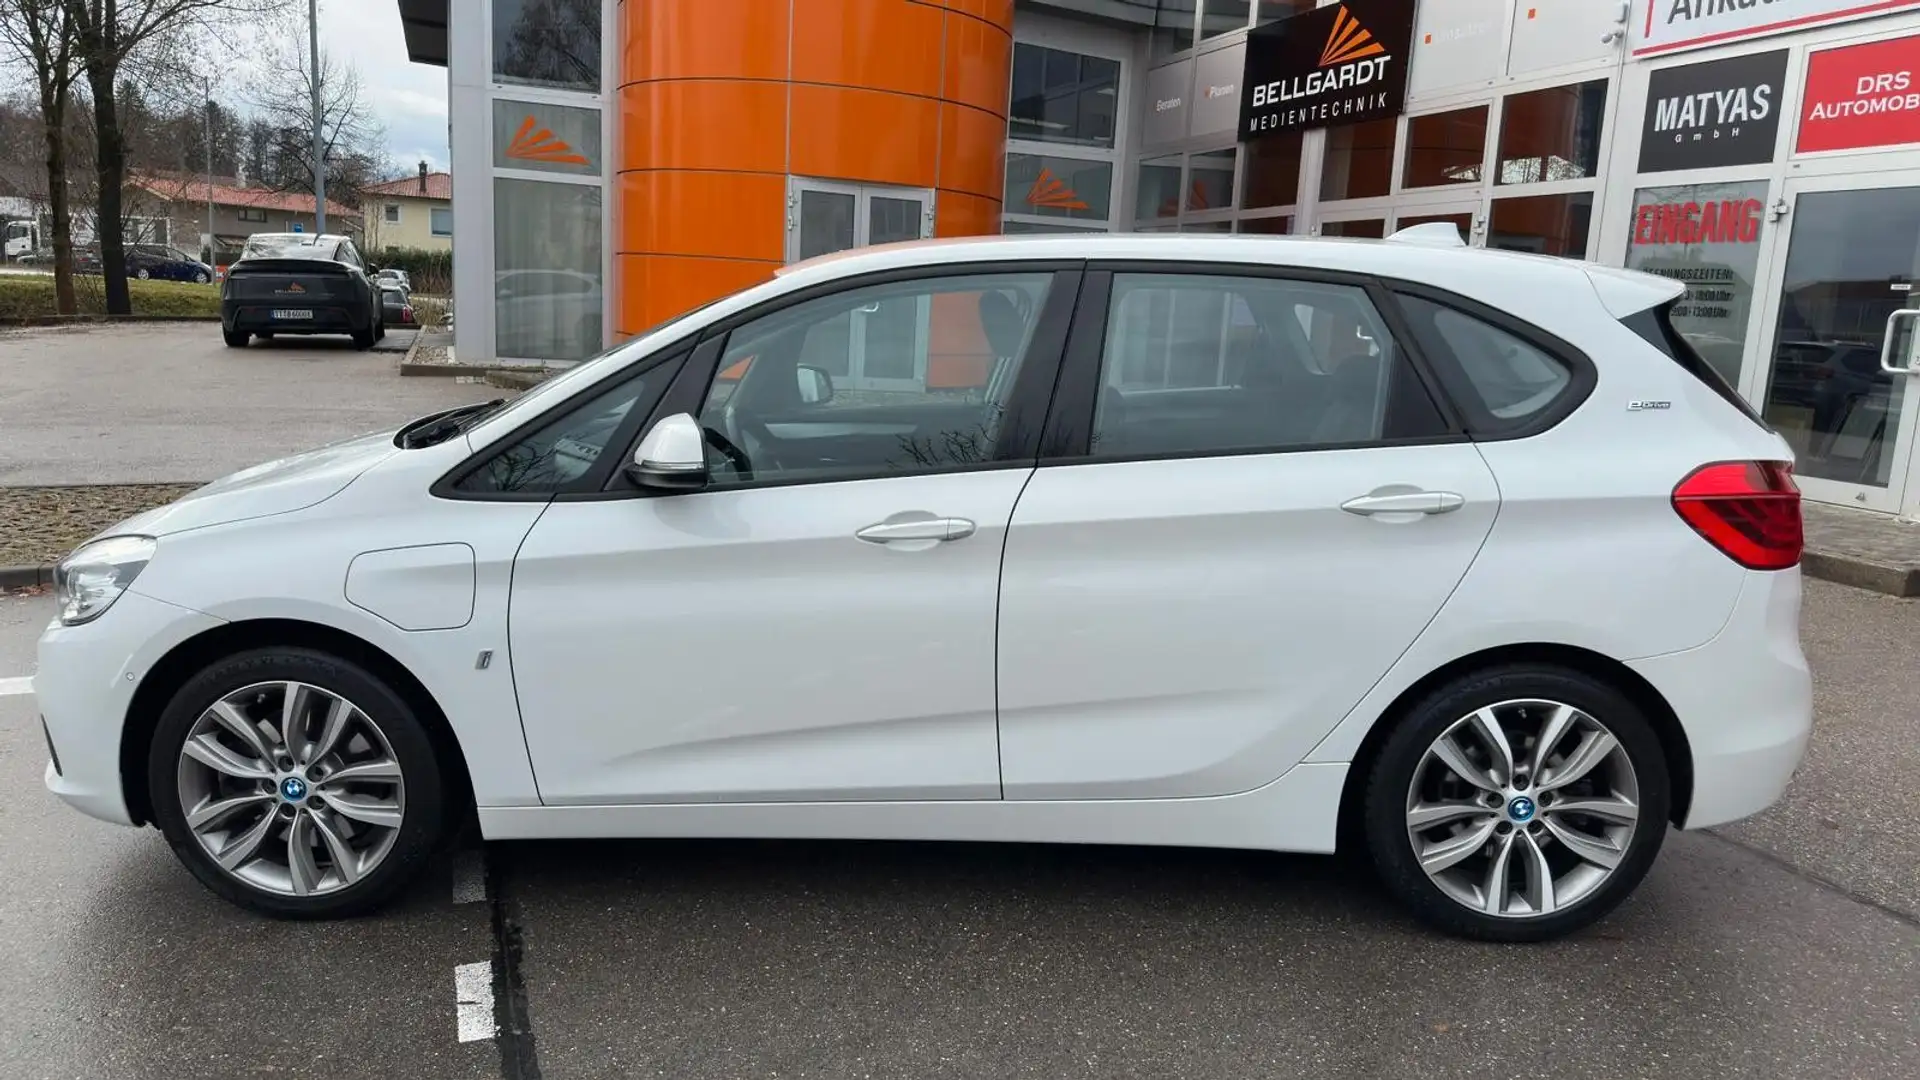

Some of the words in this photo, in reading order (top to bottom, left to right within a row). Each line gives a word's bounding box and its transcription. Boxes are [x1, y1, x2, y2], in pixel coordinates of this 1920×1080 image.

[1252, 55, 1392, 107] BELLGARDT
[1856, 71, 1912, 95] DRS
[1249, 91, 1387, 132] MEDIENTECHNIK
[1654, 84, 1772, 132] MATYAS
[1634, 198, 1765, 245] EINGANG
